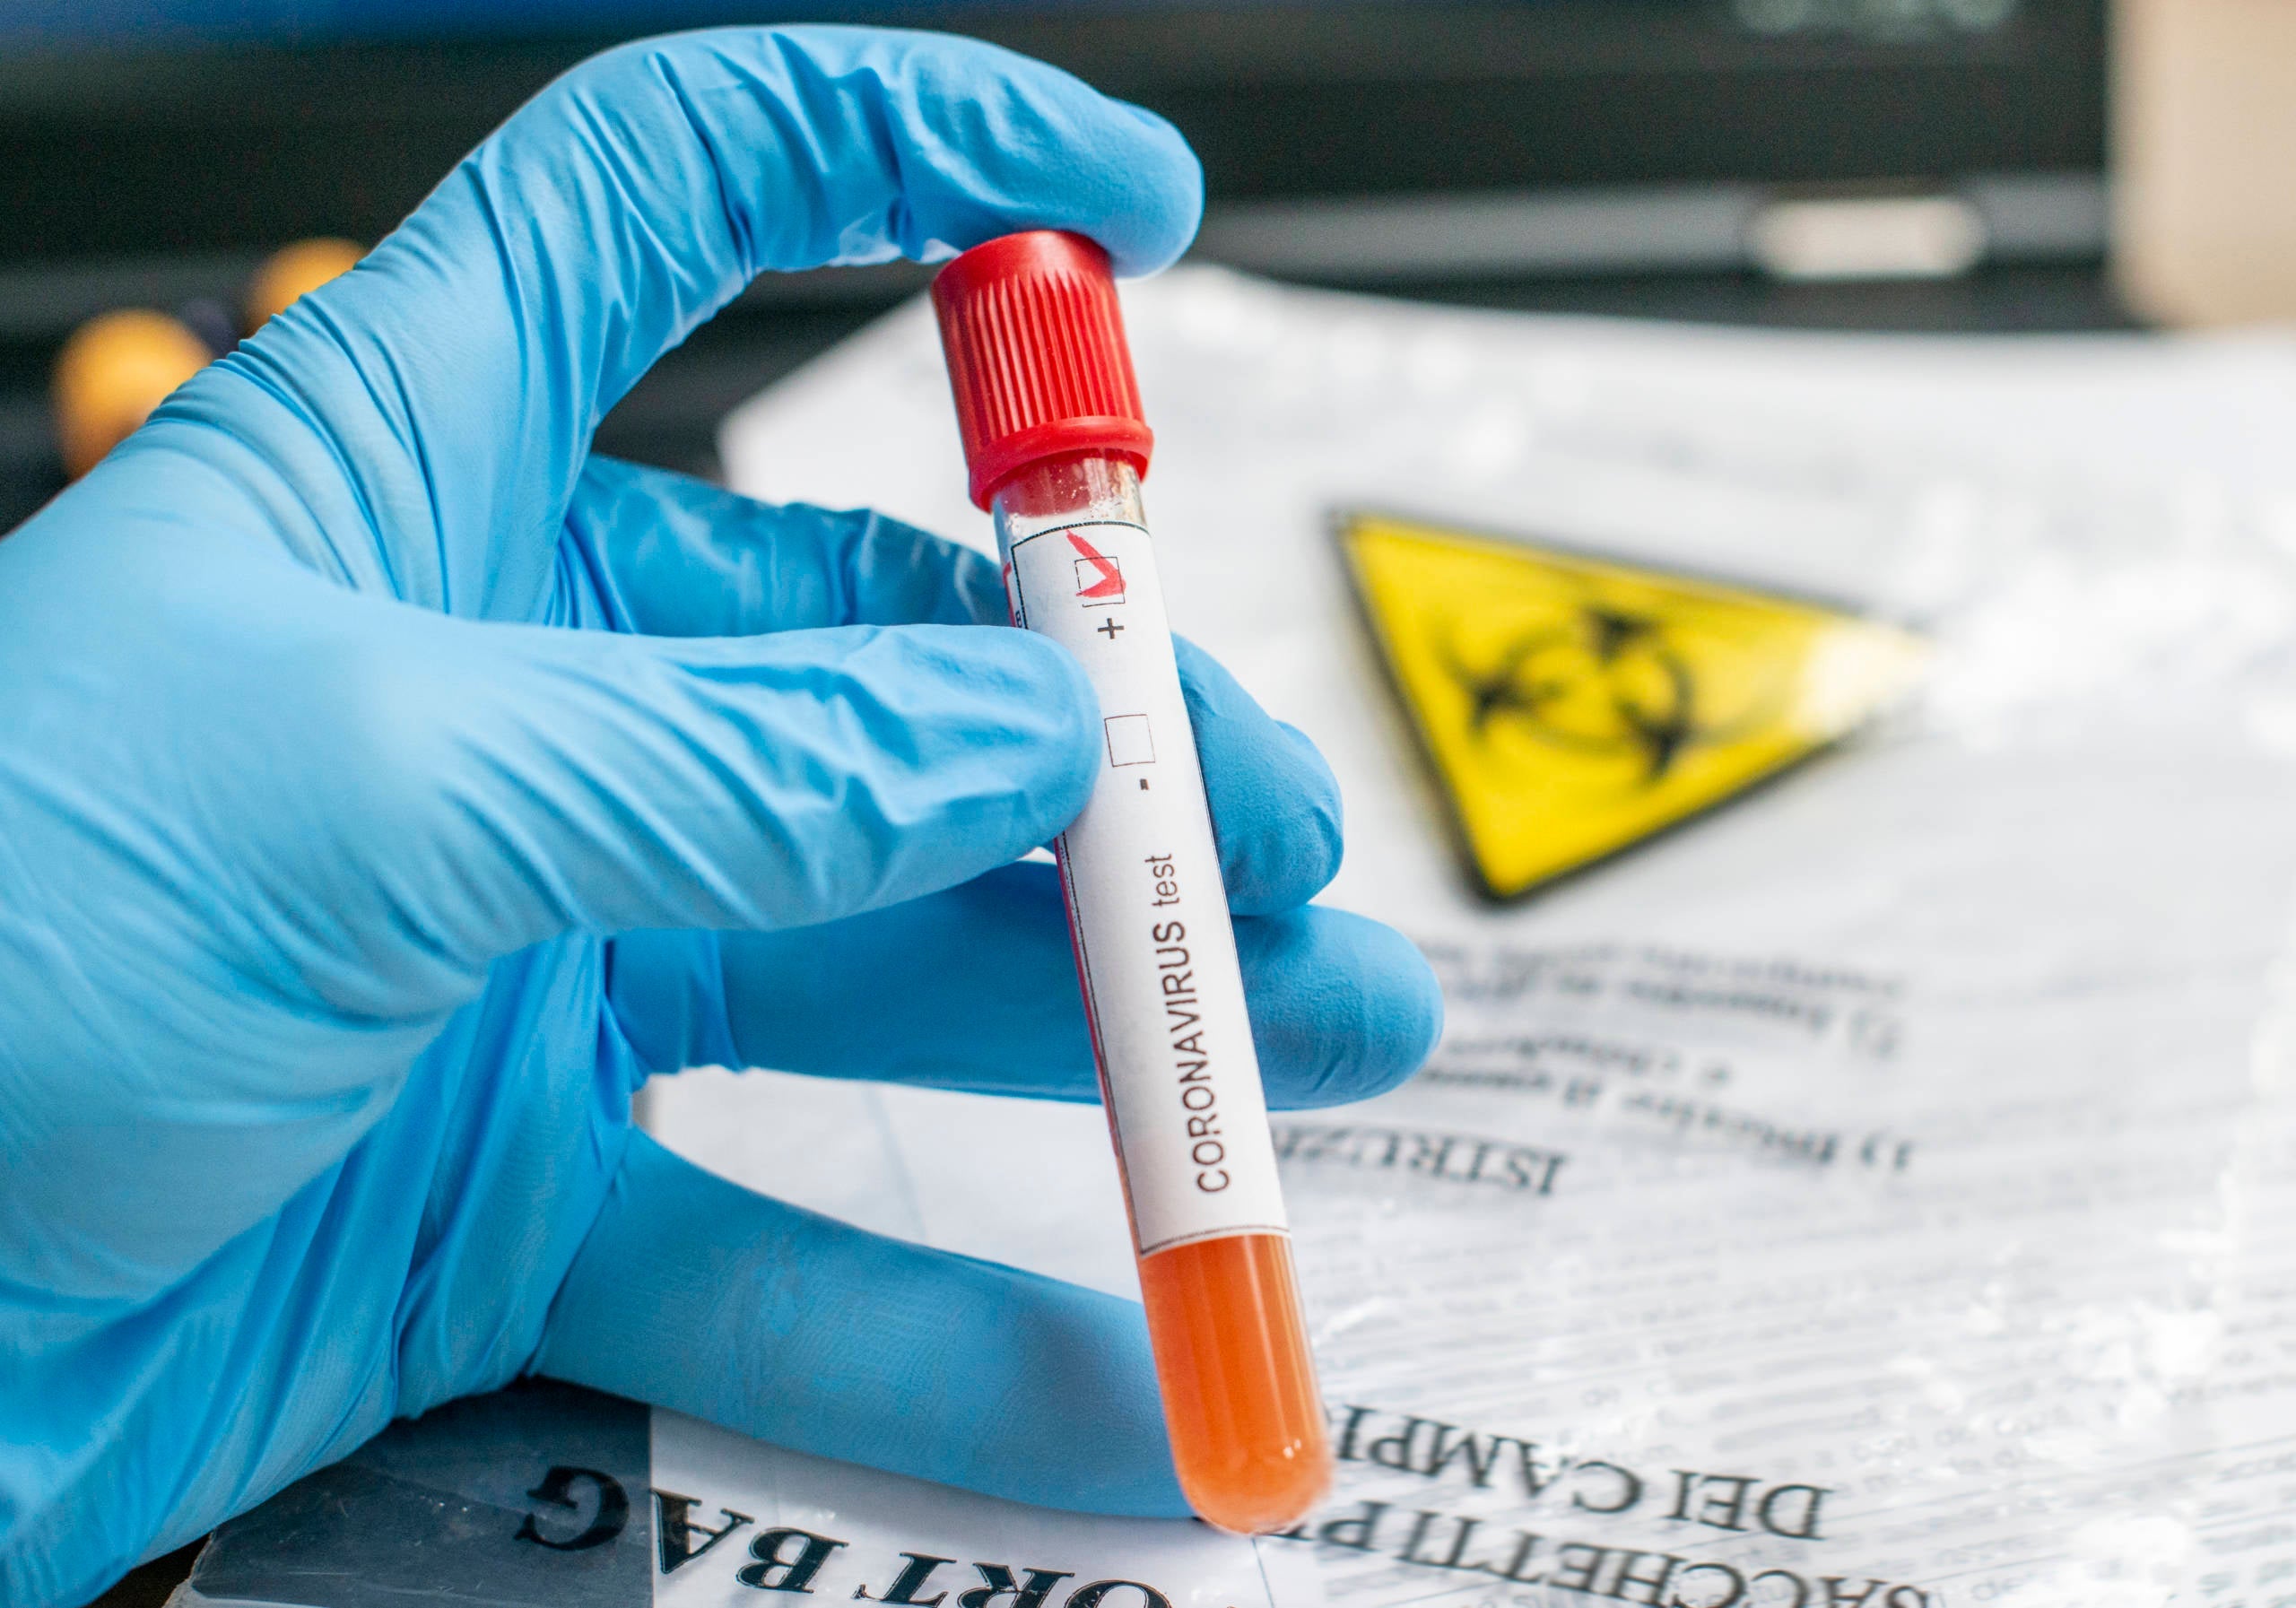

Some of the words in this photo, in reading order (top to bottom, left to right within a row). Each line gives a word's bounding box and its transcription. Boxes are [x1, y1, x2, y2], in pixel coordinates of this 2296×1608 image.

[1144, 853, 1180, 908] test
[1152, 920, 1230, 1193] CORONAVIRUS
[1271, 1126, 1569, 1196] ISTRUZI
[1329, 1404, 1643, 1514] CAMPI
[514, 1465, 850, 1595] BAG
[1666, 1469, 1833, 1541] DEI
